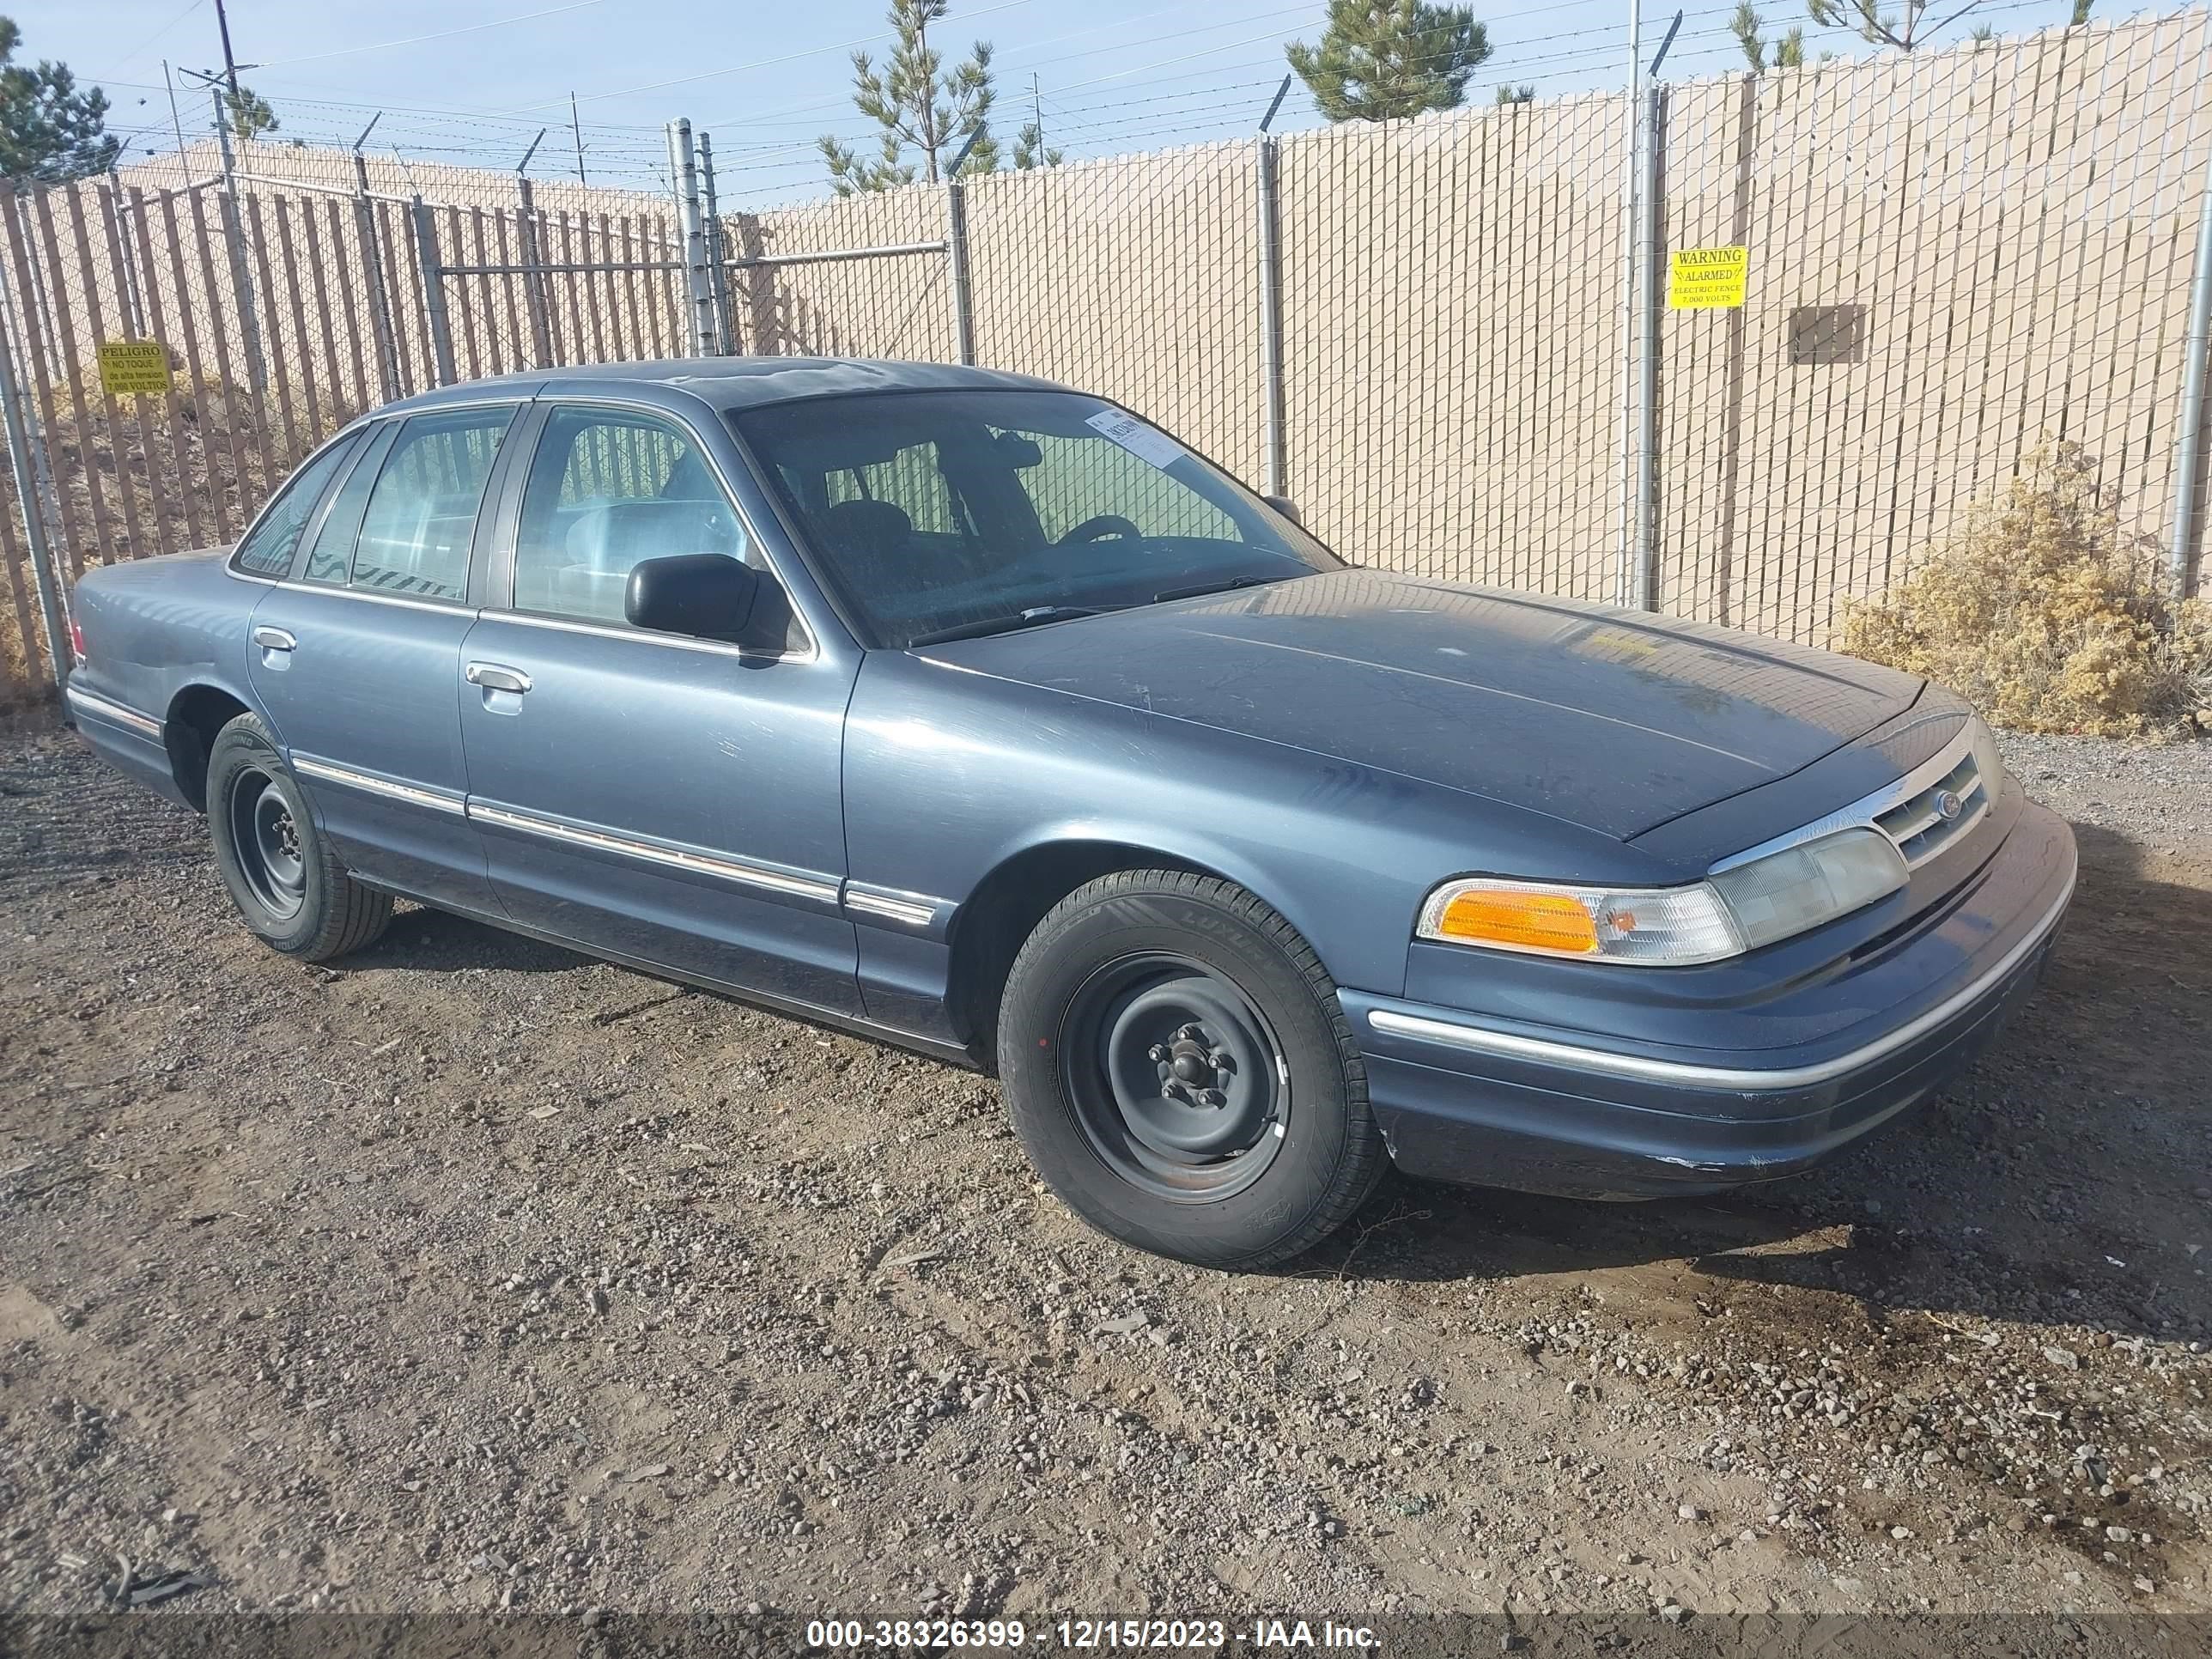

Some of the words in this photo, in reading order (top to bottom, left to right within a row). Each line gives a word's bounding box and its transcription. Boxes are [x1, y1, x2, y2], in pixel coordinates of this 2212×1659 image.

[1680, 250, 1741, 264] WARNING
[1685, 270, 1732, 282] ALARMED
[101, 347, 160, 356] PELIGRO
[112, 360, 125, 369] NO
[126, 359, 155, 369] TOQUE
[109, 372, 118, 380] de
[120, 371, 134, 380] alta
[130, 380, 168, 390] VOLTIOS
